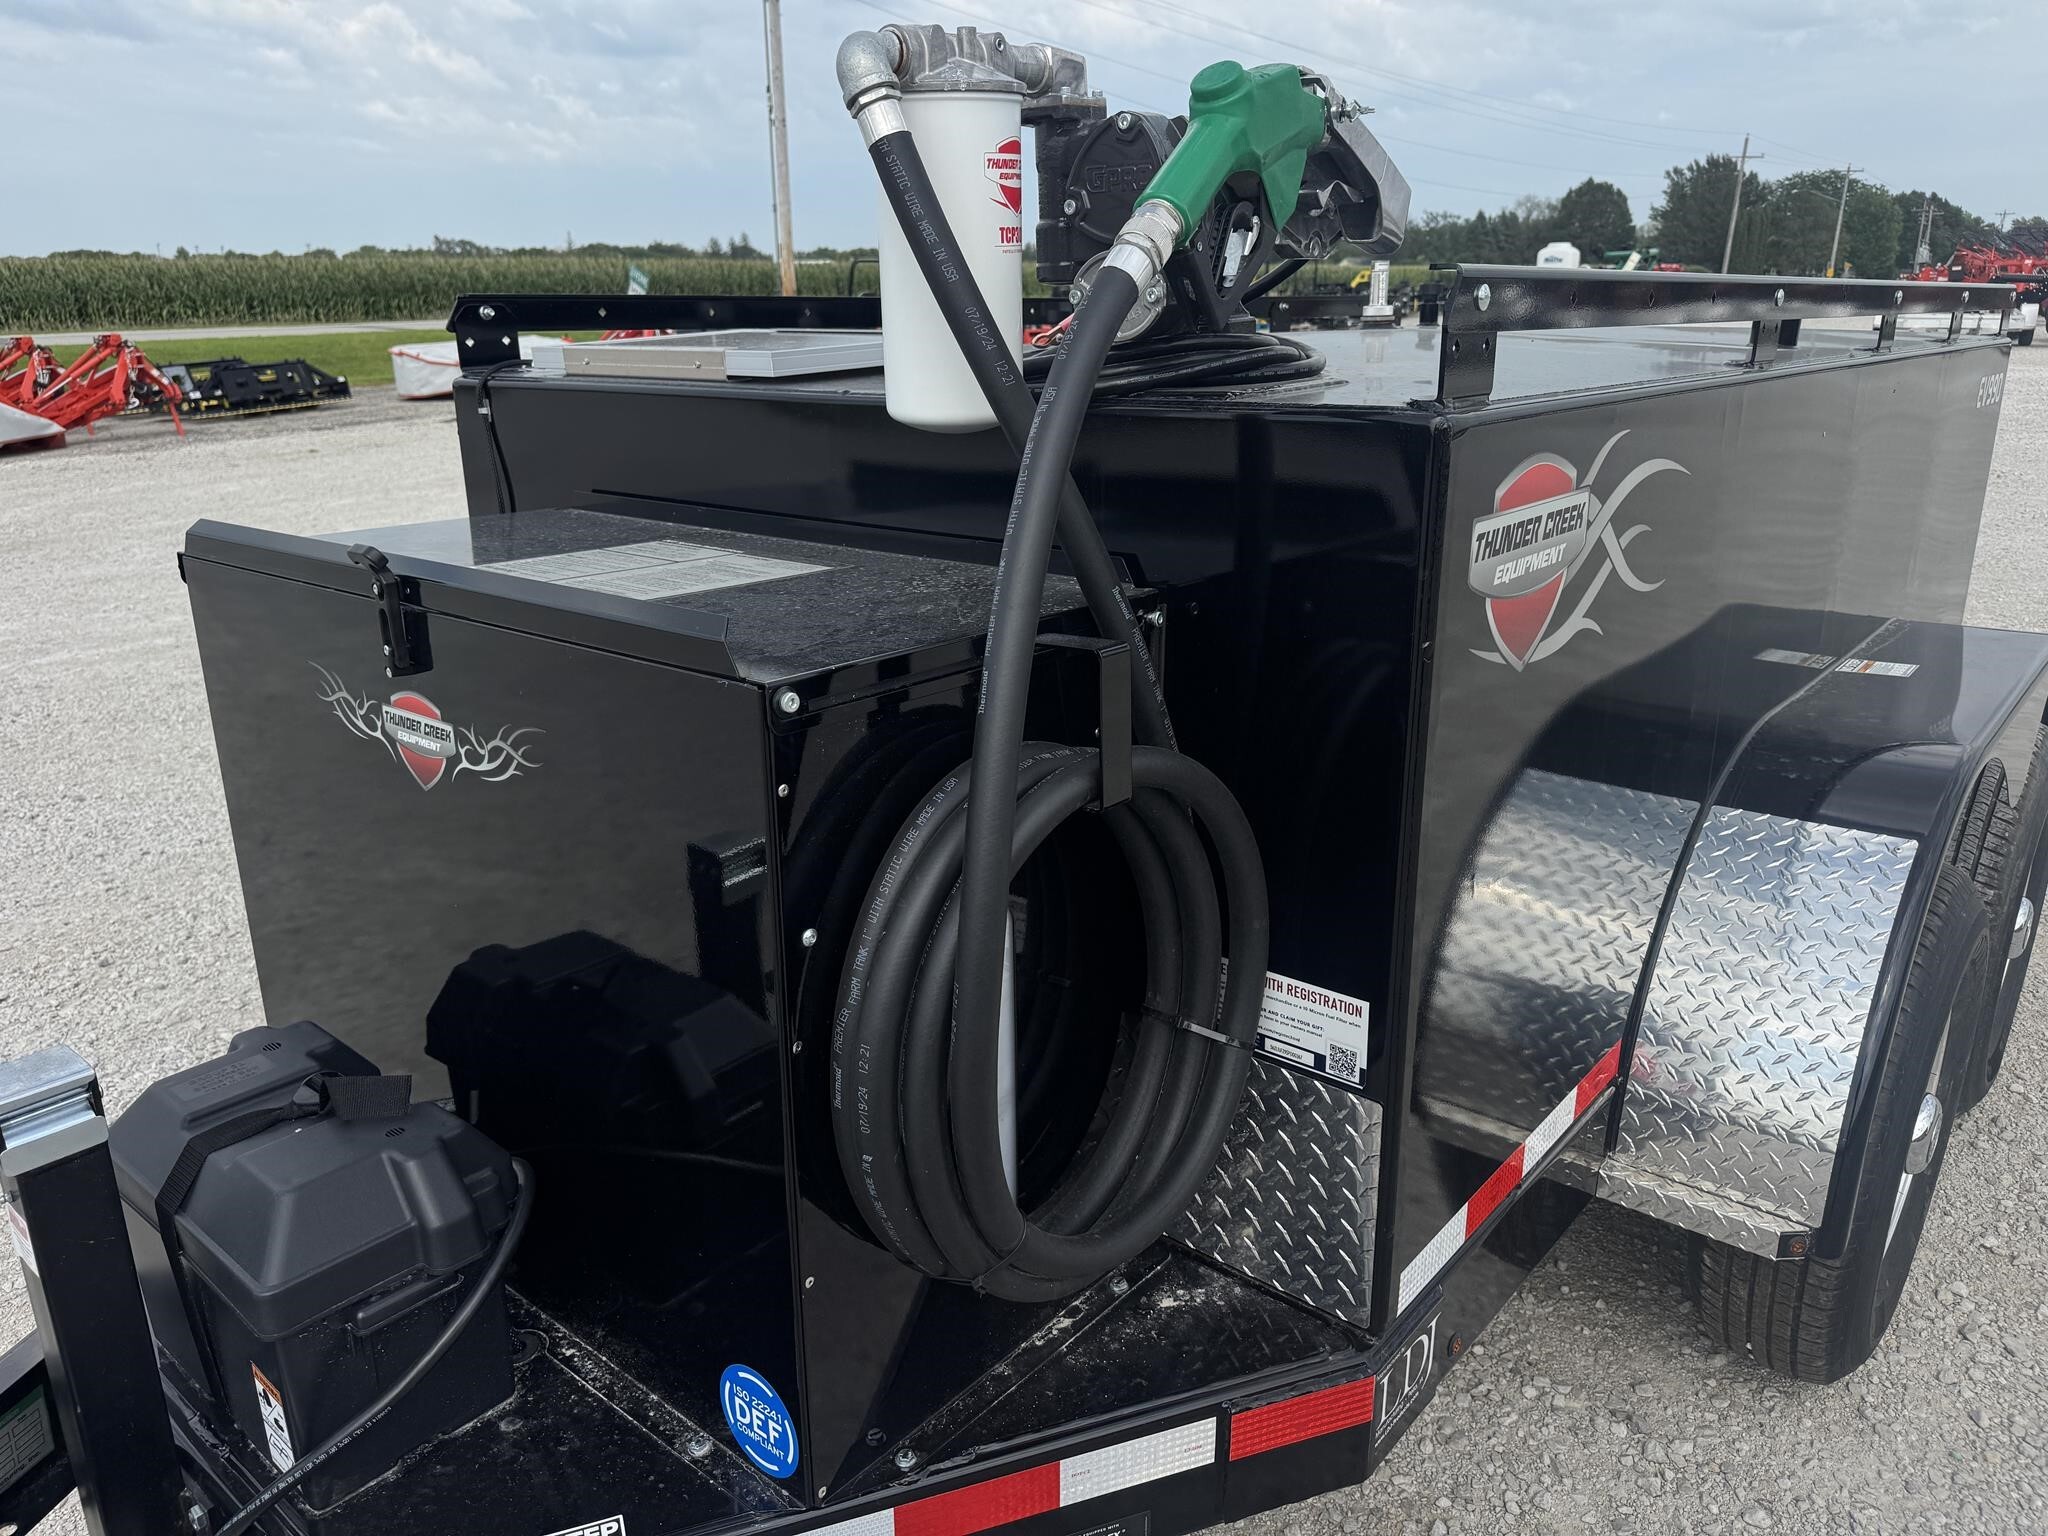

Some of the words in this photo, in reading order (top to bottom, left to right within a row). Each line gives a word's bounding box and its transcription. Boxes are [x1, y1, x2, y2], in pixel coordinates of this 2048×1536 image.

[885, 152, 911, 190] STATIC
[904, 191, 924, 218] WIRE
[917, 219, 940, 245] MADE
[933, 248, 948, 261] IN
[941, 262, 959, 283] USA
[964, 306, 998, 351] 07/19/24
[994, 360, 1016, 386] 12:21
[1976, 372, 2004, 409] EV990
[978, 668, 989, 714] Thermoid
[984, 615, 996, 657] PREMIER
[1007, 510, 1020, 536] WITH
[1014, 470, 1028, 505] STATIC
[1022, 441, 1034, 465] WIRE
[1044, 386, 1058, 402] USA
[1475, 515, 1543, 563] THUNDER
[1542, 502, 1587, 541] CREEK
[1493, 543, 1567, 586] EQUIPMENT
[1111, 585, 1133, 621] Thermoid
[1132, 627, 1149, 663] PREMIER
[384, 710, 422, 734] THUNDER
[424, 722, 452, 743] CREEK
[397, 731, 441, 752] EQUIPMENT
[932, 791, 945, 803] IN
[943, 777, 959, 792] USA
[915, 804, 936, 826] MADE
[899, 826, 920, 852] WIRE
[880, 855, 903, 894] STATIC
[867, 896, 885, 924] WITH
[862, 927, 872, 940] 1"
[852, 945, 870, 971] TANK
[847, 977, 862, 1006] FARM
[1286, 983, 1363, 1019] REGISTRATION
[833, 1007, 852, 1055] PREMIER
[1267, 1009, 1279, 1017] AND
[1280, 1013, 1296, 1023] CLAIM
[1297, 1018, 1311, 1028] YOUR
[858, 1044, 871, 1075] 12:21
[833, 1064, 842, 1110] Thermoid
[857, 1085, 871, 1135] 07/19/24
[1376, 1312, 1442, 1432] LDJ
[733, 1383, 750, 1402] ISO
[751, 1396, 782, 1425] 22241
[734, 1395, 783, 1445] DEF
[737, 1422, 785, 1460] COMPLIANT
